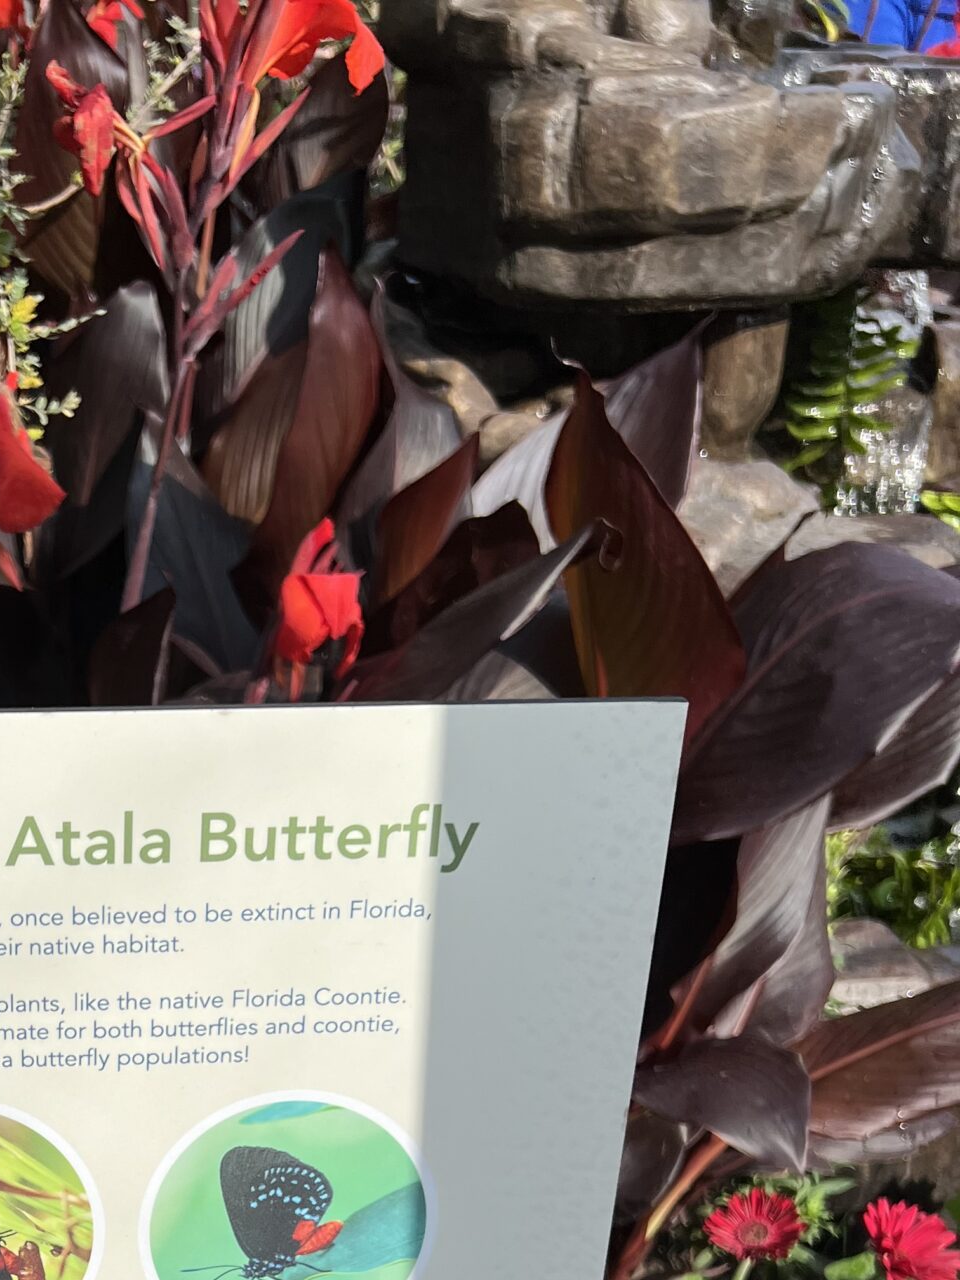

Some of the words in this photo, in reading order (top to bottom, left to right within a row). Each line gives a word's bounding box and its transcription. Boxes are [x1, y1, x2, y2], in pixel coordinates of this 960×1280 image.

[5, 811, 171, 867] Atala
[200, 803, 480, 873] Butterfly
[11, 912, 63, 927] once
[72, 904, 166, 925] believed
[174, 907, 197, 923] to
[205, 902, 232, 922] be
[241, 902, 315, 921] extinct
[323, 901, 340, 919] in
[350, 898, 433, 922] Florida,
[30, 937, 95, 955] native
[103, 933, 184, 954] habitat.
[75, 992, 110, 1011] like
[117, 992, 152, 1011] the
[160, 991, 224, 1011] native
[232, 988, 305, 1009] Florida
[314, 987, 406, 1006] Coontie.
[56, 1020, 87, 1040] for
[93, 1019, 142, 1039] both
[150, 1017, 258, 1038] butterflies
[265, 1015, 305, 1035] and
[313, 1015, 399, 1036] coontie,
[21, 1047, 110, 1072] butterfly
[117, 1045, 250, 1072] populations!
